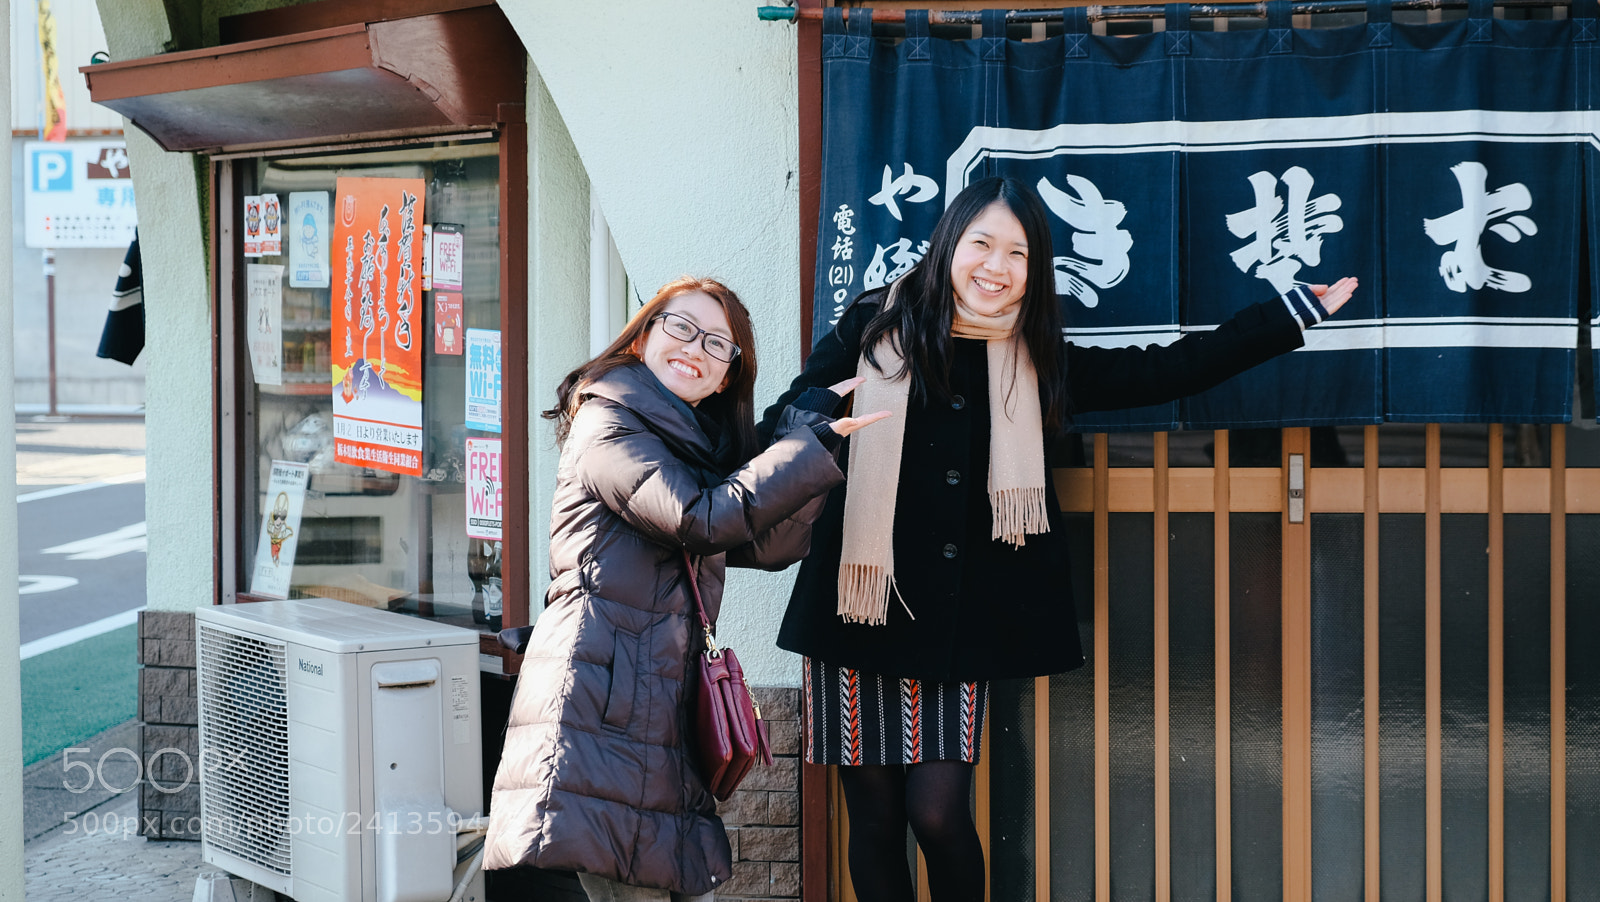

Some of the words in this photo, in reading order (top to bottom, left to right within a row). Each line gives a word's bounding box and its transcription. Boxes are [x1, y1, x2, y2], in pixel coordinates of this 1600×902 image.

[38, 151, 68, 192] P
[439, 241, 457, 257] FREE
[298, 657, 324, 677] National
